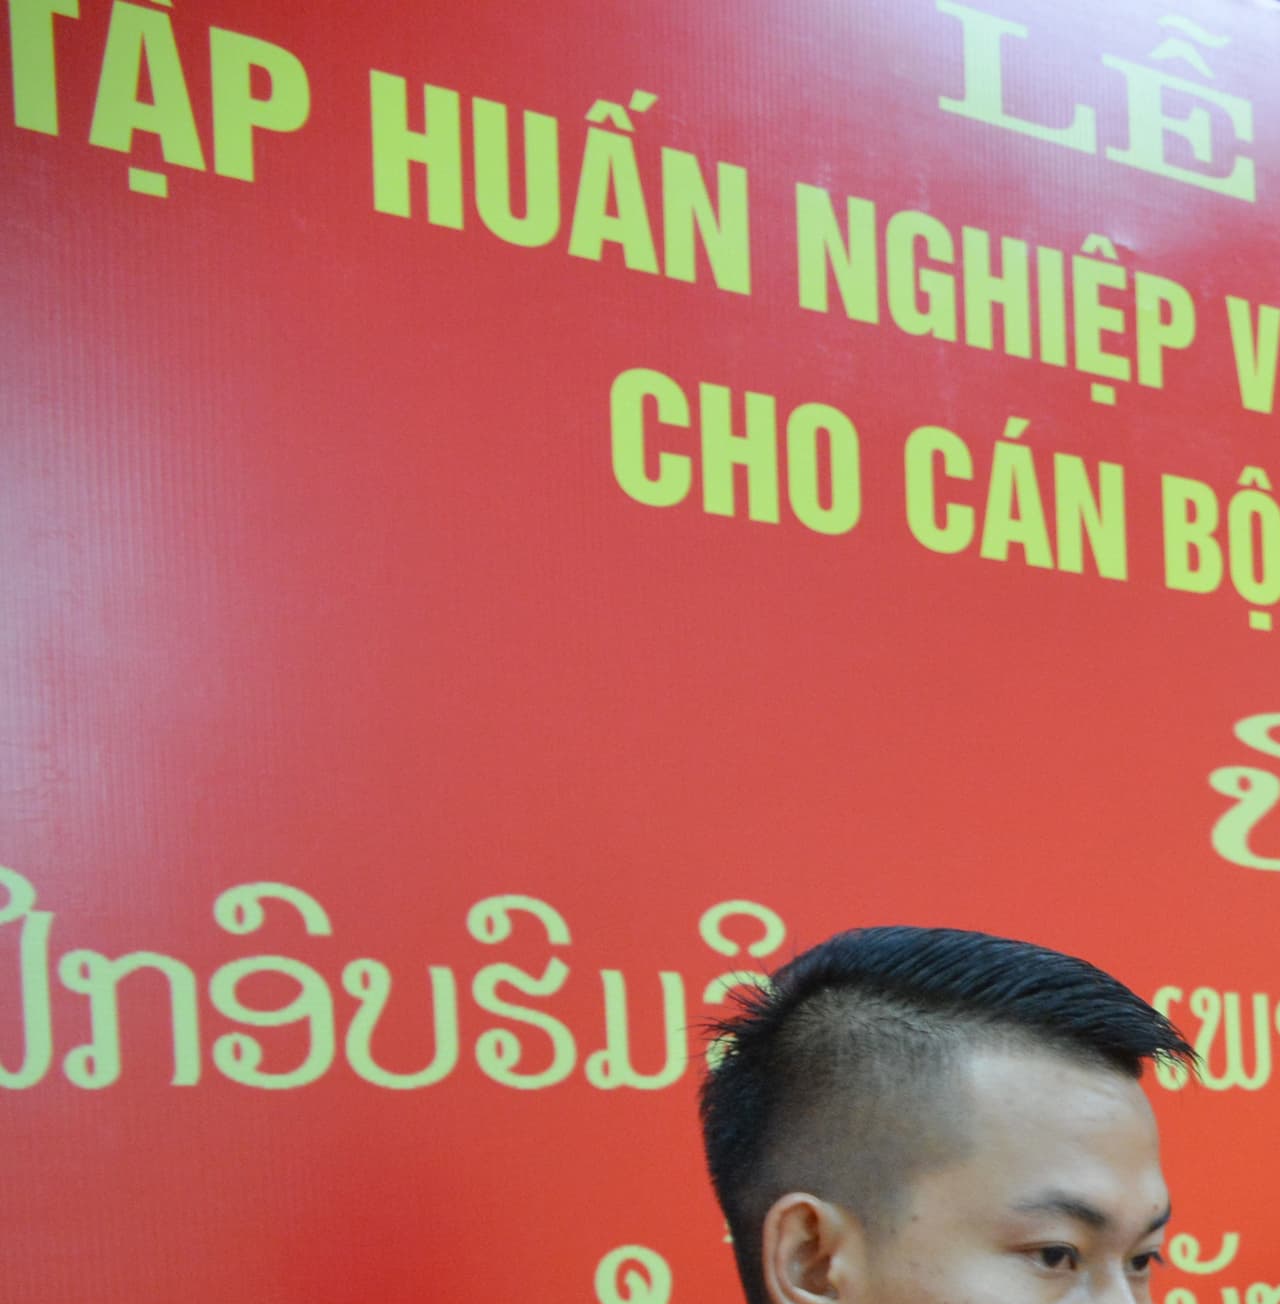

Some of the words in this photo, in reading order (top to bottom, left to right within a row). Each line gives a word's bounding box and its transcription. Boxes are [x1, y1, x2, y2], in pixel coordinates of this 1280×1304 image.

[937, 0, 1255, 202] LỄ
[371, 70, 751, 294] HUẤN
[797, 184, 1195, 404] NGHIỆP
[611, 368, 861, 534] CHO
[905, 417, 1127, 580] CÁN
